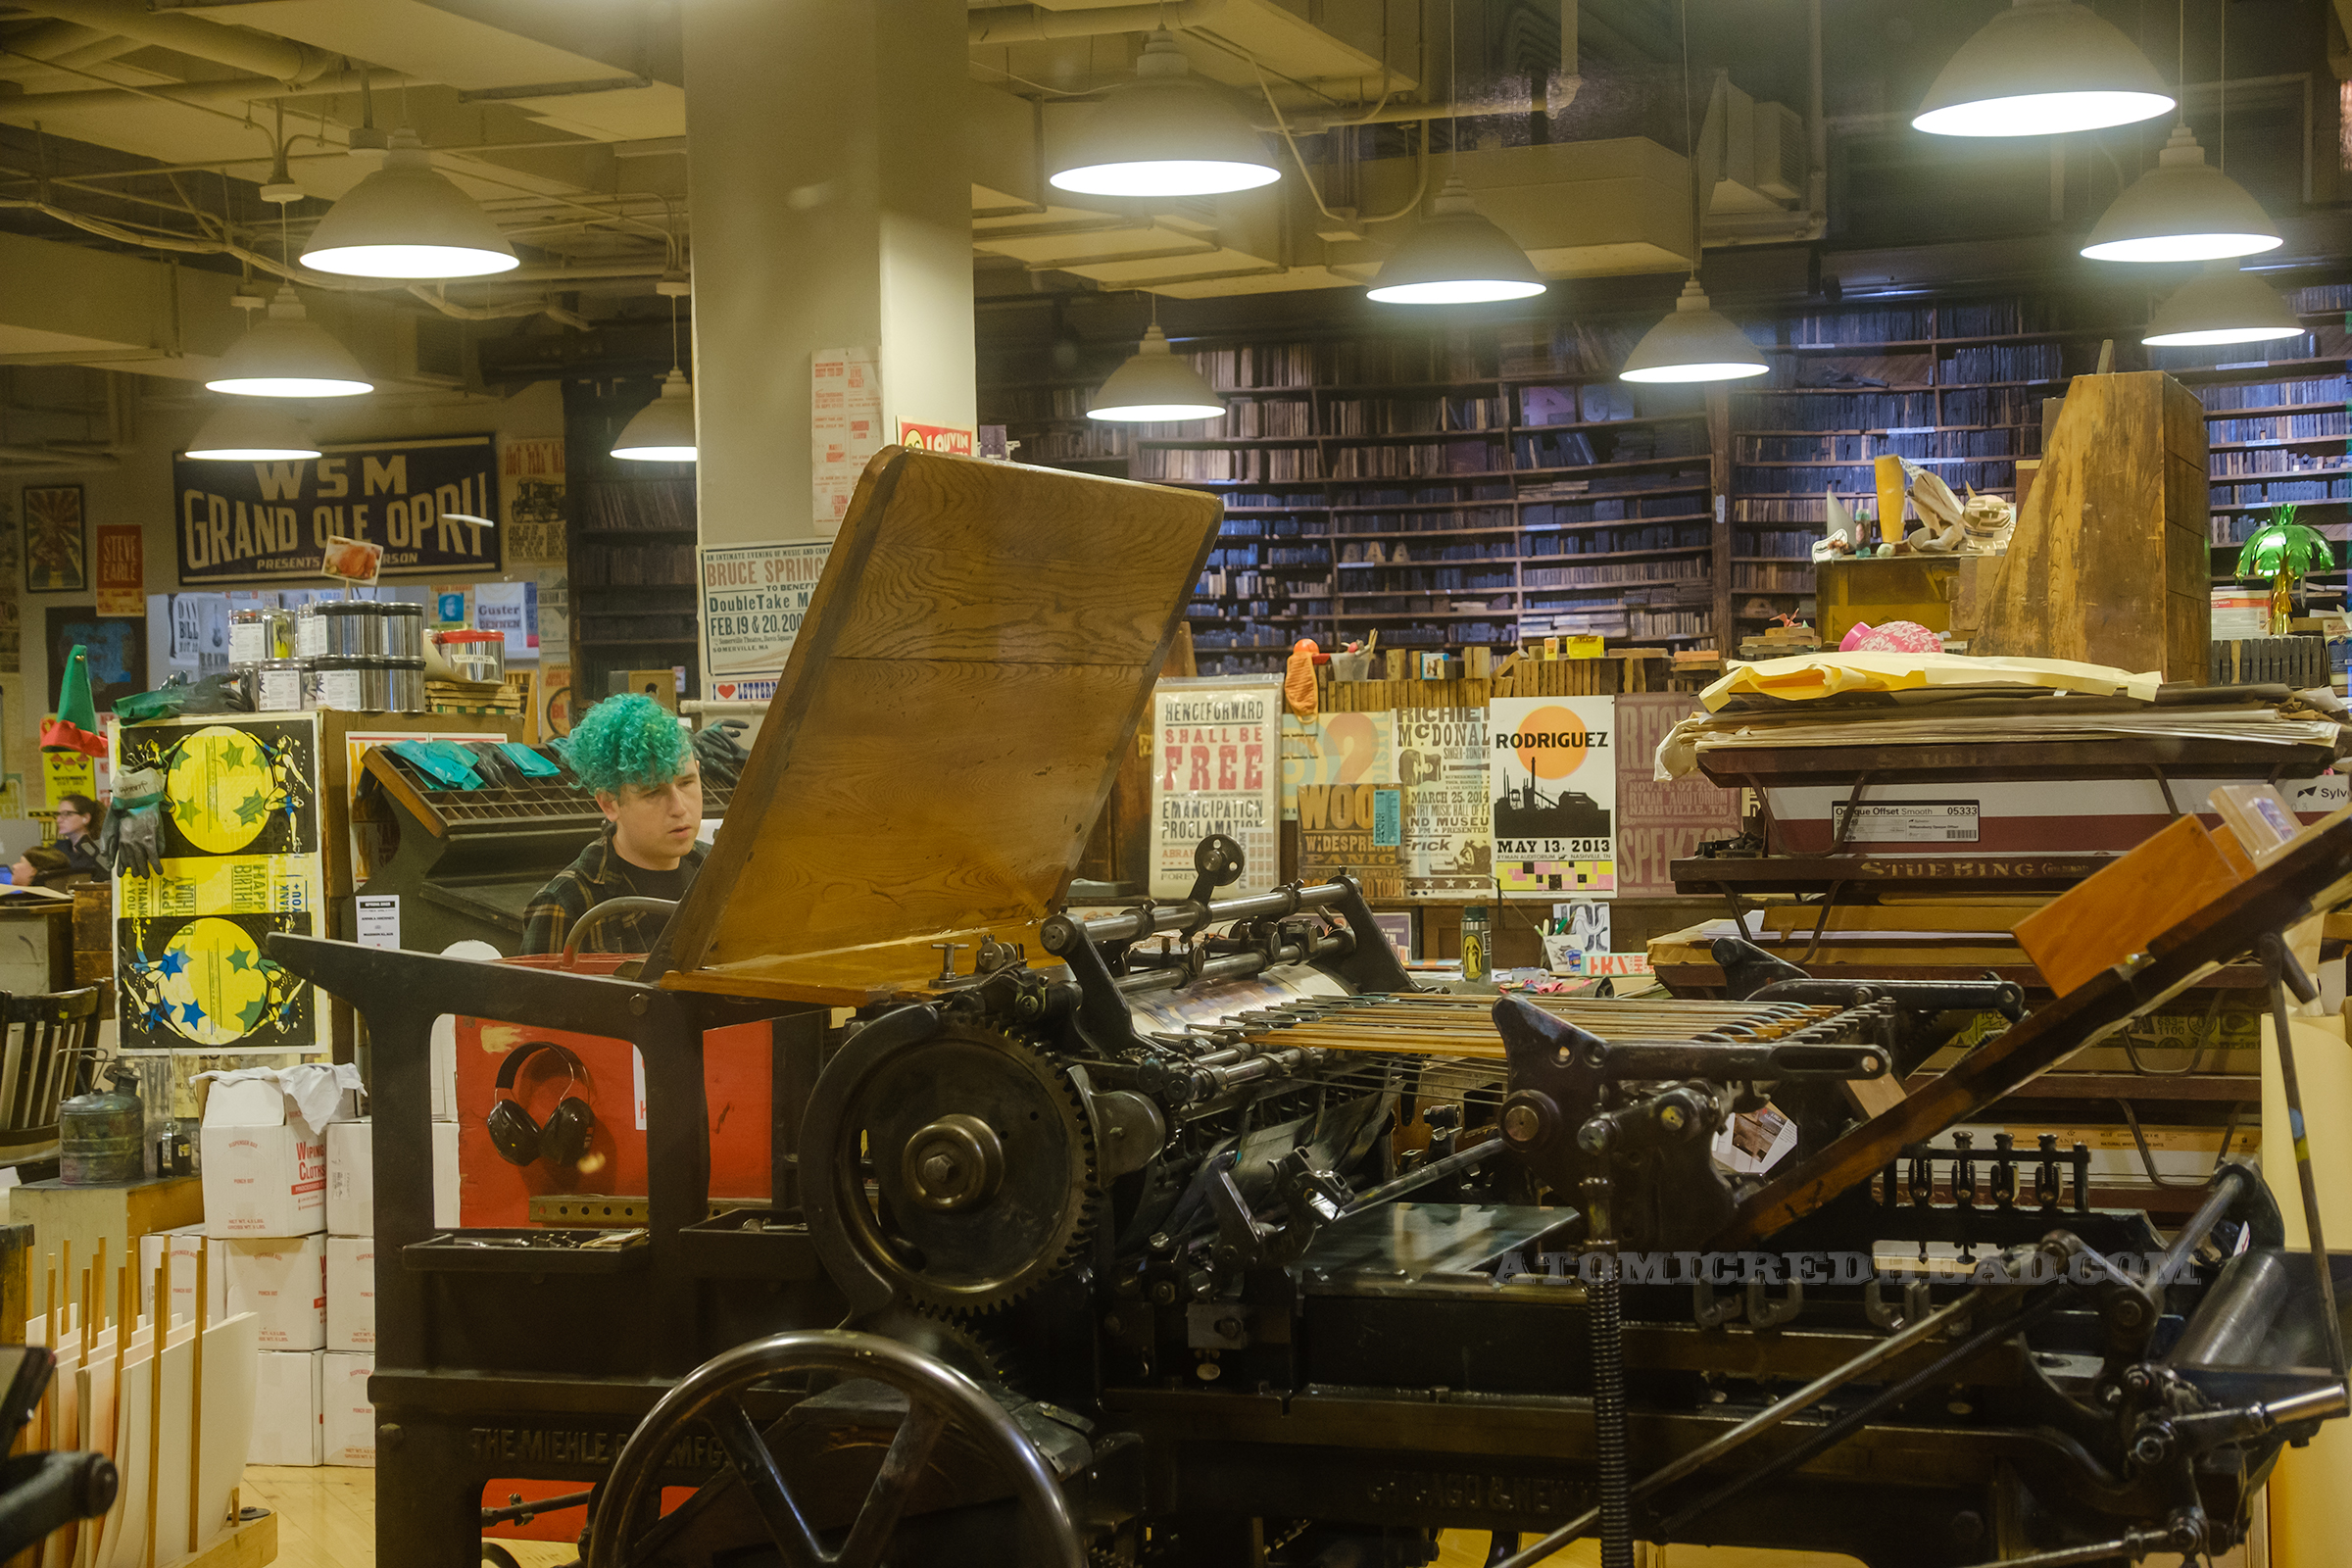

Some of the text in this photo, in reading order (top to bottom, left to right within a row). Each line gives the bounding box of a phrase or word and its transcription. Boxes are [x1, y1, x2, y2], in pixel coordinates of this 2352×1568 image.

[184, 489, 298, 570] GRAND
[386, 471, 490, 557] OPRY
[103, 535, 137, 563] STEVE
[715, 553, 745, 562] INTIMATE
[747, 550, 772, 560] EVENING
[257, 556, 321, 570] PRESENTS
[103, 562, 137, 582] EARLE
[707, 557, 827, 587] BRUCE SPRING
[710, 592, 814, 612] DoubleTake M
[478, 605, 520, 615] Guster
[752, 615, 760, 634] &
[1165, 701, 1263, 721] HENCEFORWARD
[1165, 726, 1262, 744] SHALL BE
[1495, 731, 1609, 749] RODRIGUEZ
[1163, 744, 1263, 791] FREE
[1411, 792, 1447, 804] MARCH
[1467, 791, 1489, 804] 2014
[1629, 792, 1728, 805] RYMAN AUDITORIUM
[2321, 788, 2349, 800] Sylv
[1162, 799, 1263, 819] EMANCIPATION
[1431, 805, 1452, 817] MUSIC
[1453, 804, 1469, 816] HALL
[1472, 804, 1479, 816] OF
[1709, 805, 1727, 815] TN
[1836, 807, 1978, 816] Oque Offset Smooth 05333
[1437, 817, 1490, 827] MUSEU
[1497, 841, 1538, 854] MAY
[1571, 840, 1610, 853] 2013
[1304, 854, 1397, 864] PANIC
[228, 1140, 249, 1149] DISPENSER
[471, 1427, 515, 1459] THE
[520, 1430, 610, 1465] MIEHLE
